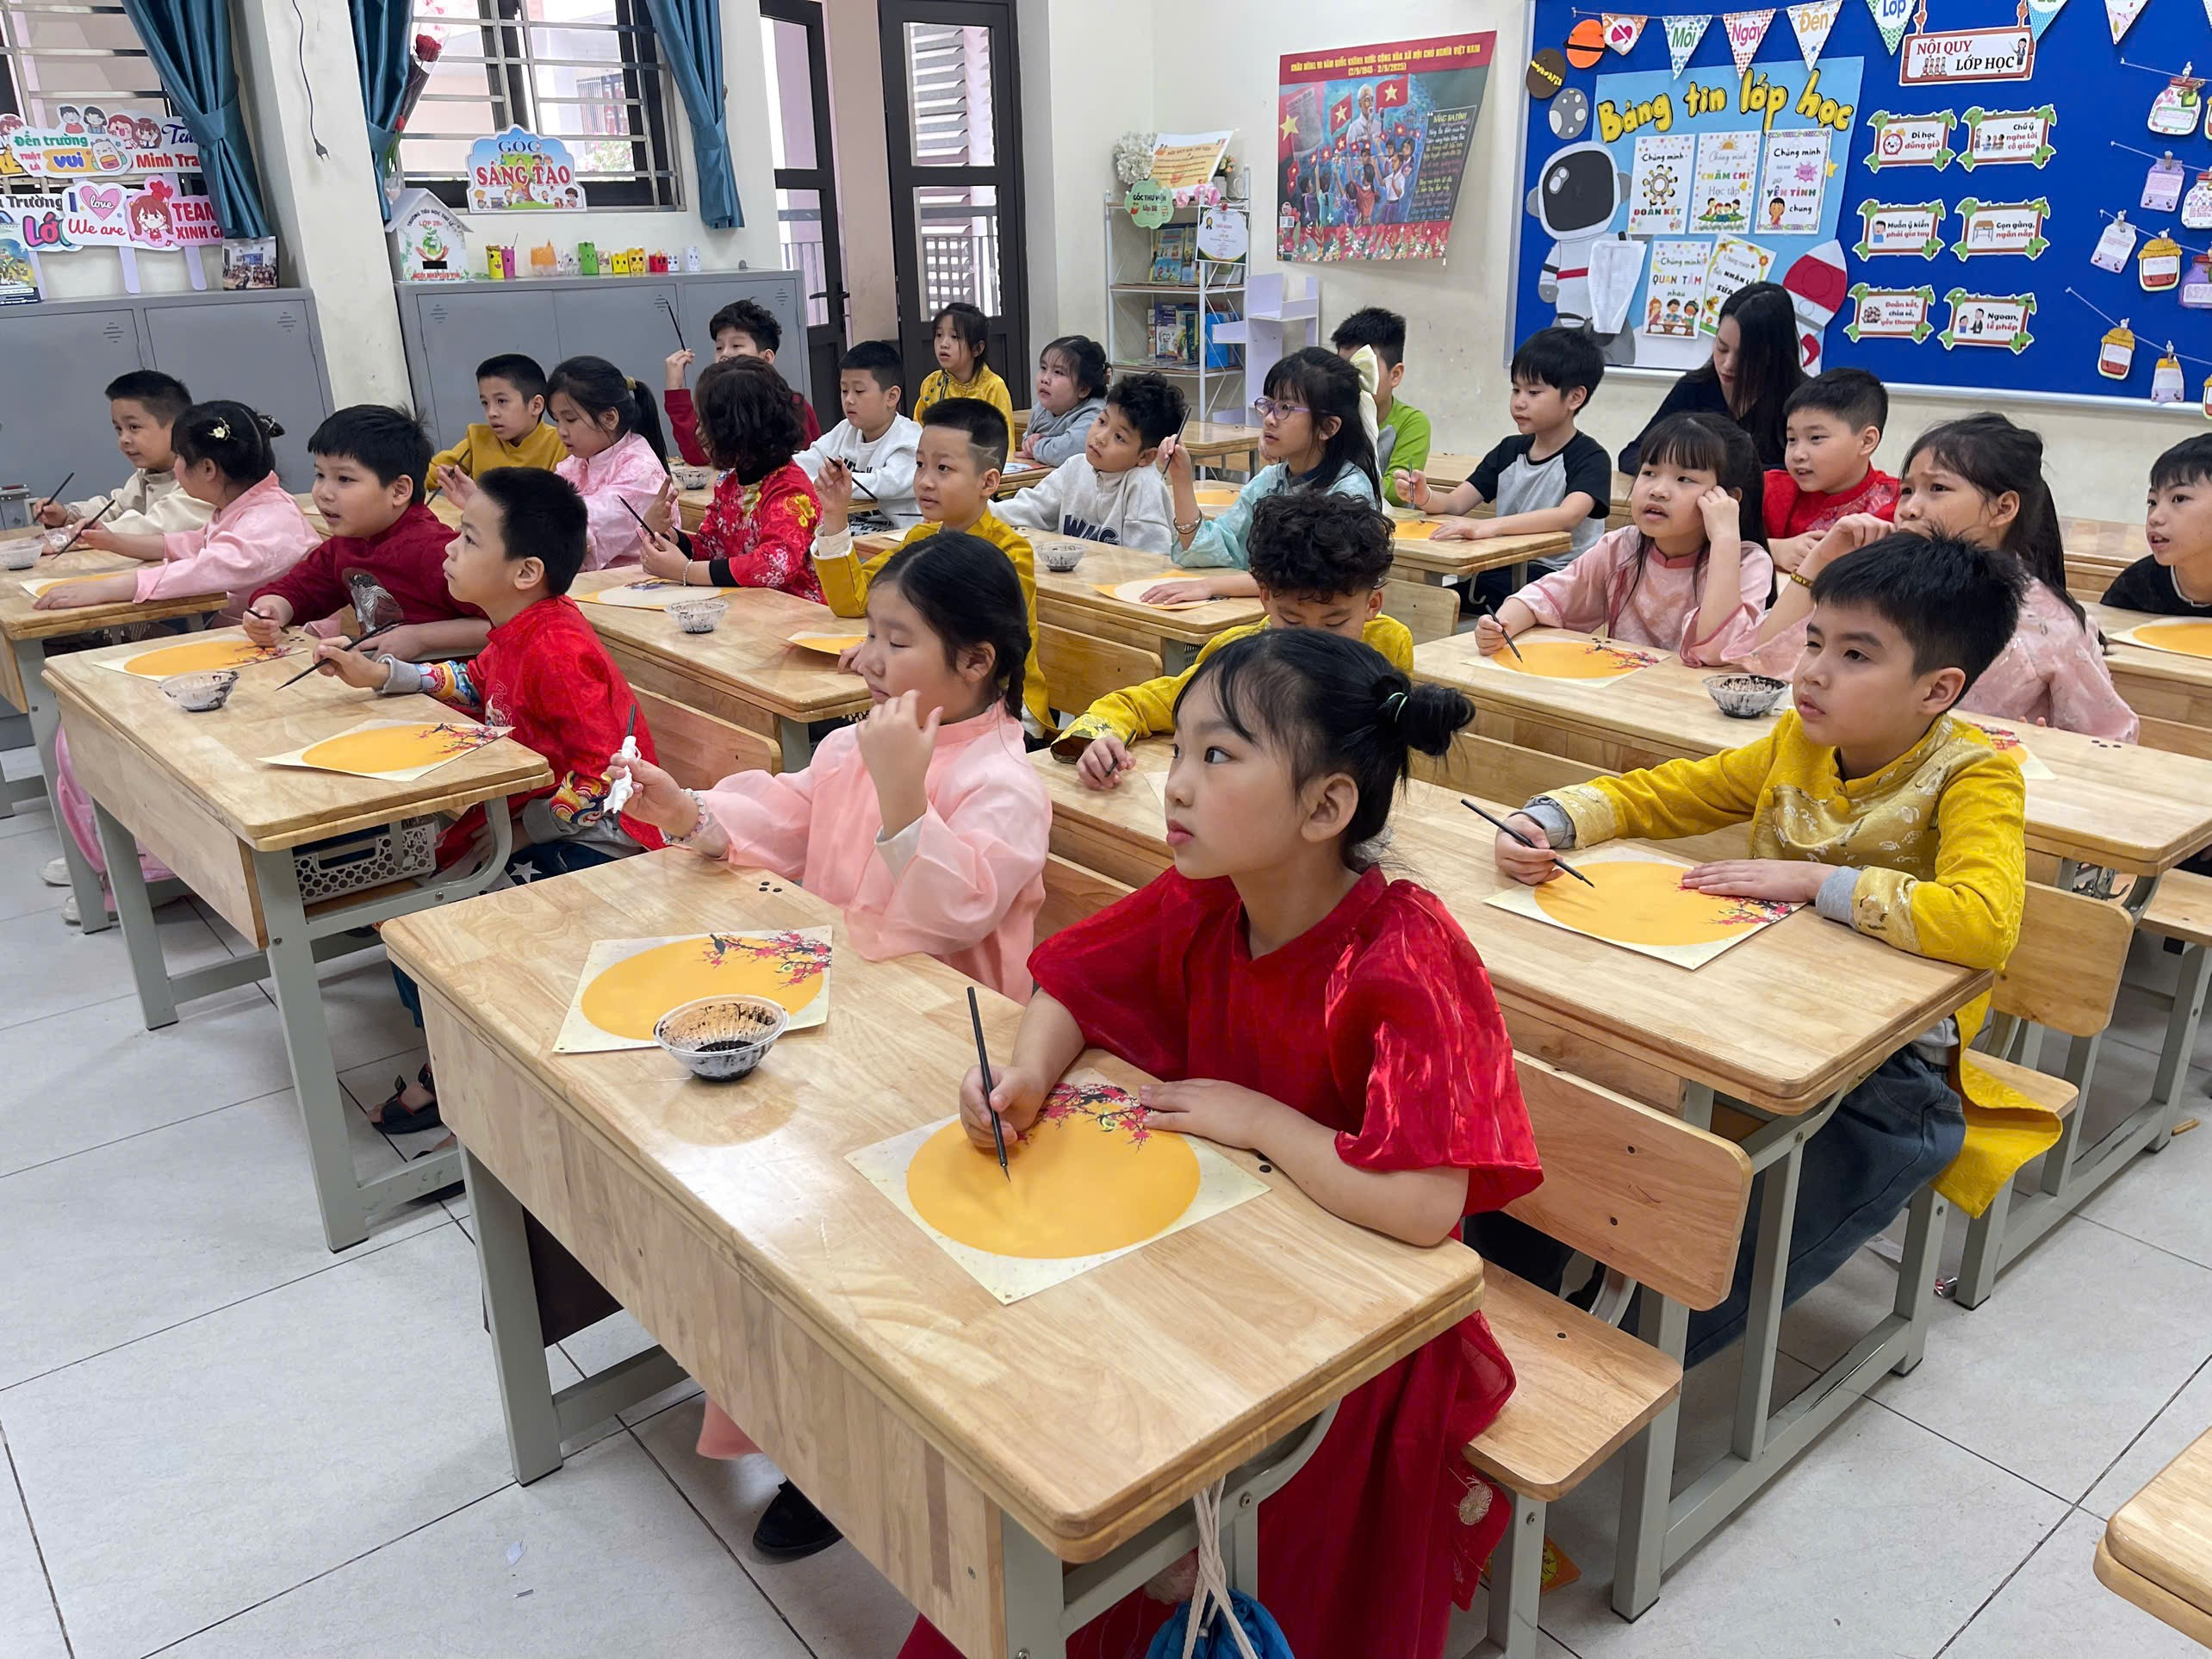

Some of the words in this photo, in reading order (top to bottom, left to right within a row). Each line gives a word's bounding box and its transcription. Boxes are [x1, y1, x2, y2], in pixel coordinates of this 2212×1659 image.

[1799, 5, 1830, 34] Đến
[1671, 22, 1698, 48] Mỗi
[1731, 21, 1763, 47] Ngày
[1917, 39, 1941, 59] NỘI
[1943, 40, 1973, 54] QUY
[1955, 54, 1982, 71] LỚP
[1985, 56, 2015, 72] HỌC
[1597, 92, 1674, 143] Bảng
[1683, 81, 1728, 117] tin
[1739, 68, 1788, 135] lớp
[1794, 68, 1855, 131] học
[2029, 121, 2035, 131] ý
[14, 131, 41, 146] Đến
[43, 133, 89, 147] trường
[1922, 132, 1936, 140] học
[2027, 131, 2037, 140] lời
[499, 138, 542, 152] GÓC
[1904, 140, 1926, 150] đúng
[2008, 141, 2016, 150] cô
[2017, 141, 2035, 151] giáo
[136, 152, 174, 168] Minh
[476, 161, 528, 186] SÁNG
[532, 165, 570, 191] TẠO
[1701, 170, 1730, 180] CHĂM
[1709, 186, 1724, 196] Học
[1726, 186, 1740, 196] tập
[1767, 185, 1787, 197] YÊN
[6, 195, 62, 211] Trường
[69, 192, 78, 212] I
[90, 195, 115, 208] love
[1663, 205, 1681, 215] KẾT
[1789, 204, 1812, 214] chung
[69, 219, 97, 234] We
[101, 227, 127, 236] are
[176, 226, 208, 239] XINH
[1653, 274, 1677, 284] QUAN
[1682, 273, 1702, 285] TÂM
[1987, 312, 2019, 321] Ngoan,
[1996, 322, 2017, 332] phép
